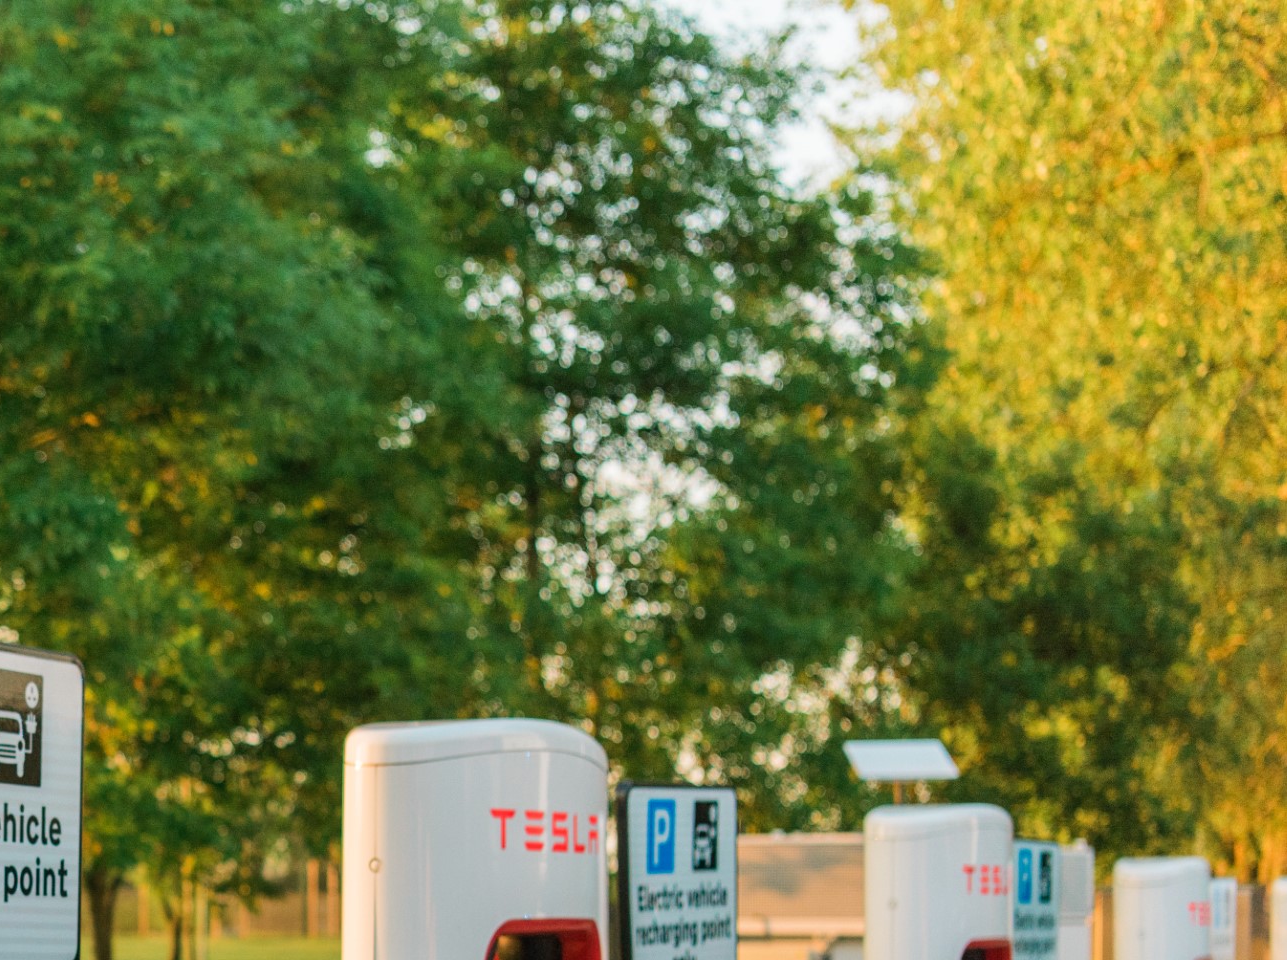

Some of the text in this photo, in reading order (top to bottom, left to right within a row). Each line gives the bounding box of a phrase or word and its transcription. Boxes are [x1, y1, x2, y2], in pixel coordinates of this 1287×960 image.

[489, 808, 599, 855] TESLA
[652, 808, 671, 866] P
[3, 857, 68, 903] point
[637, 880, 728, 912] Electric vehicle
[635, 913, 731, 948] recharging point
